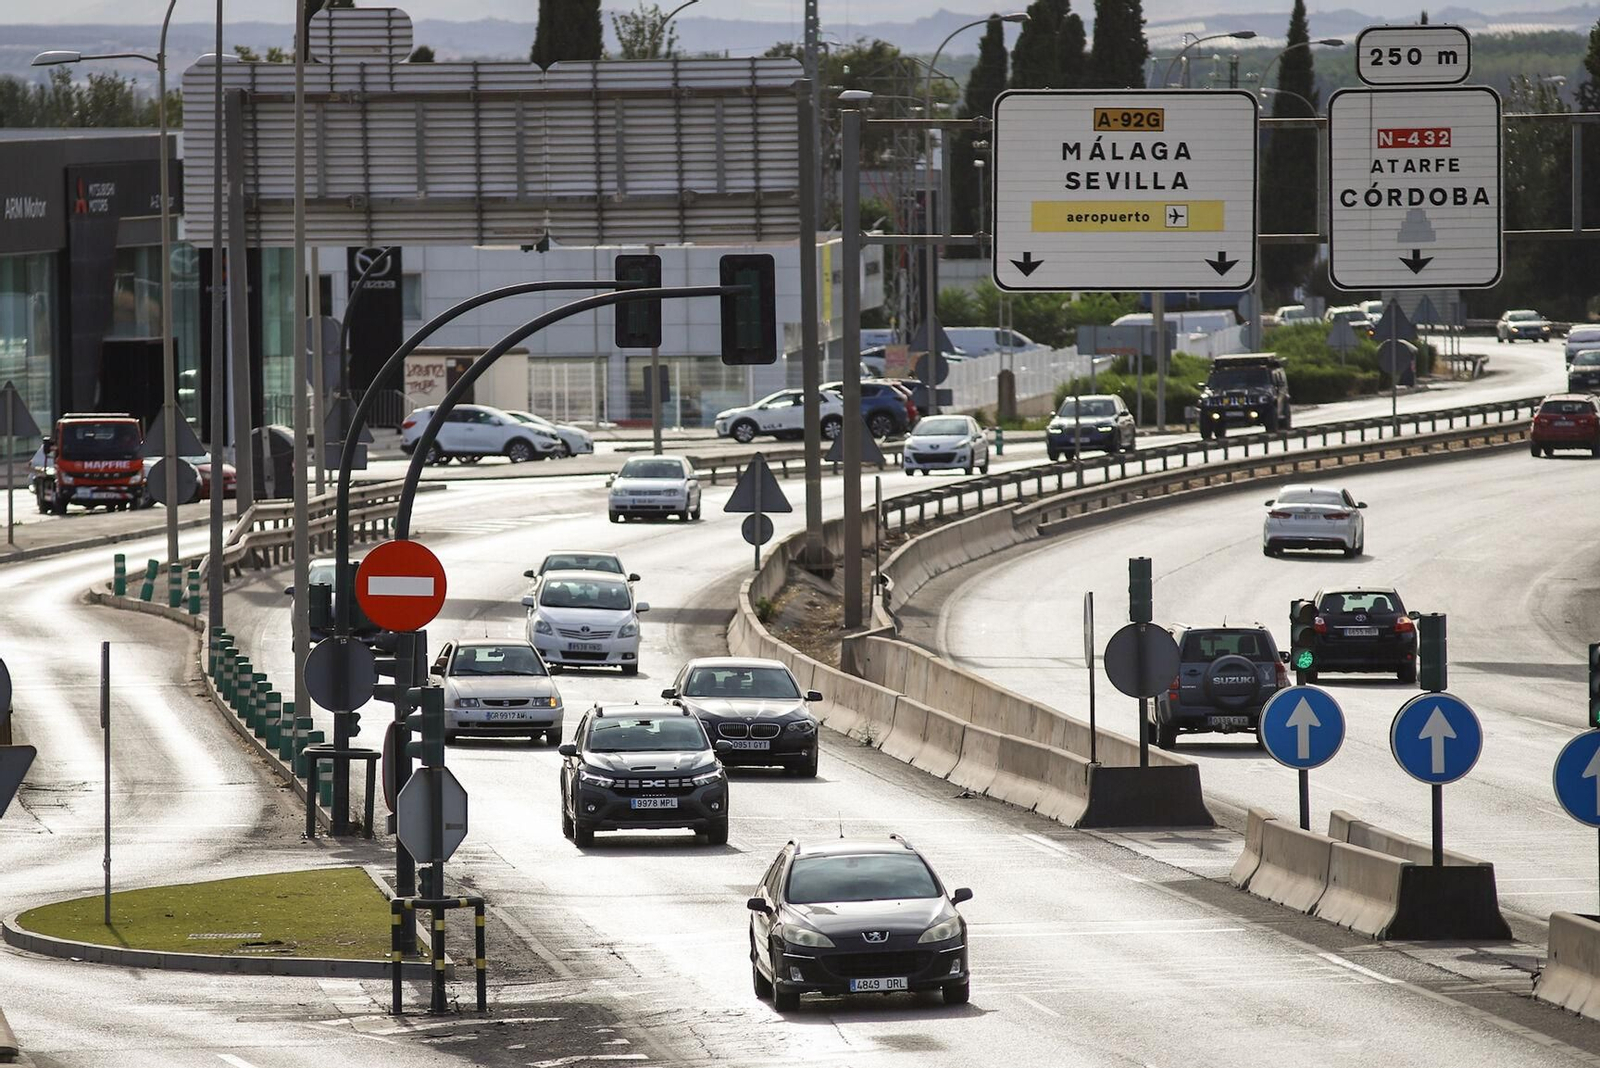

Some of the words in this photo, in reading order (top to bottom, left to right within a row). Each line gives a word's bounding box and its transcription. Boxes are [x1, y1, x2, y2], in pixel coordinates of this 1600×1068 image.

[1370, 48, 1422, 66] 250
[1437, 50, 1458, 65] m
[1097, 112, 1160, 128] A-92G
[1379, 131, 1450, 146] N-432
[1062, 135, 1191, 161] MÁLAGA
[1370, 158, 1460, 173] ATARFE
[1065, 171, 1189, 190] SEVILLA
[1340, 182, 1490, 207] CÓRDOBA
[24, 196, 47, 218] Motor
[1067, 211, 1150, 224] aeropuerto
[84, 460, 130, 469] MAPFRE
[1213, 676, 1255, 685] SUZUKI
[733, 741, 751, 749] 0951
[637, 800, 658, 808] 9978
[857, 980, 880, 989] 4849
[886, 978, 906, 989] DRL
